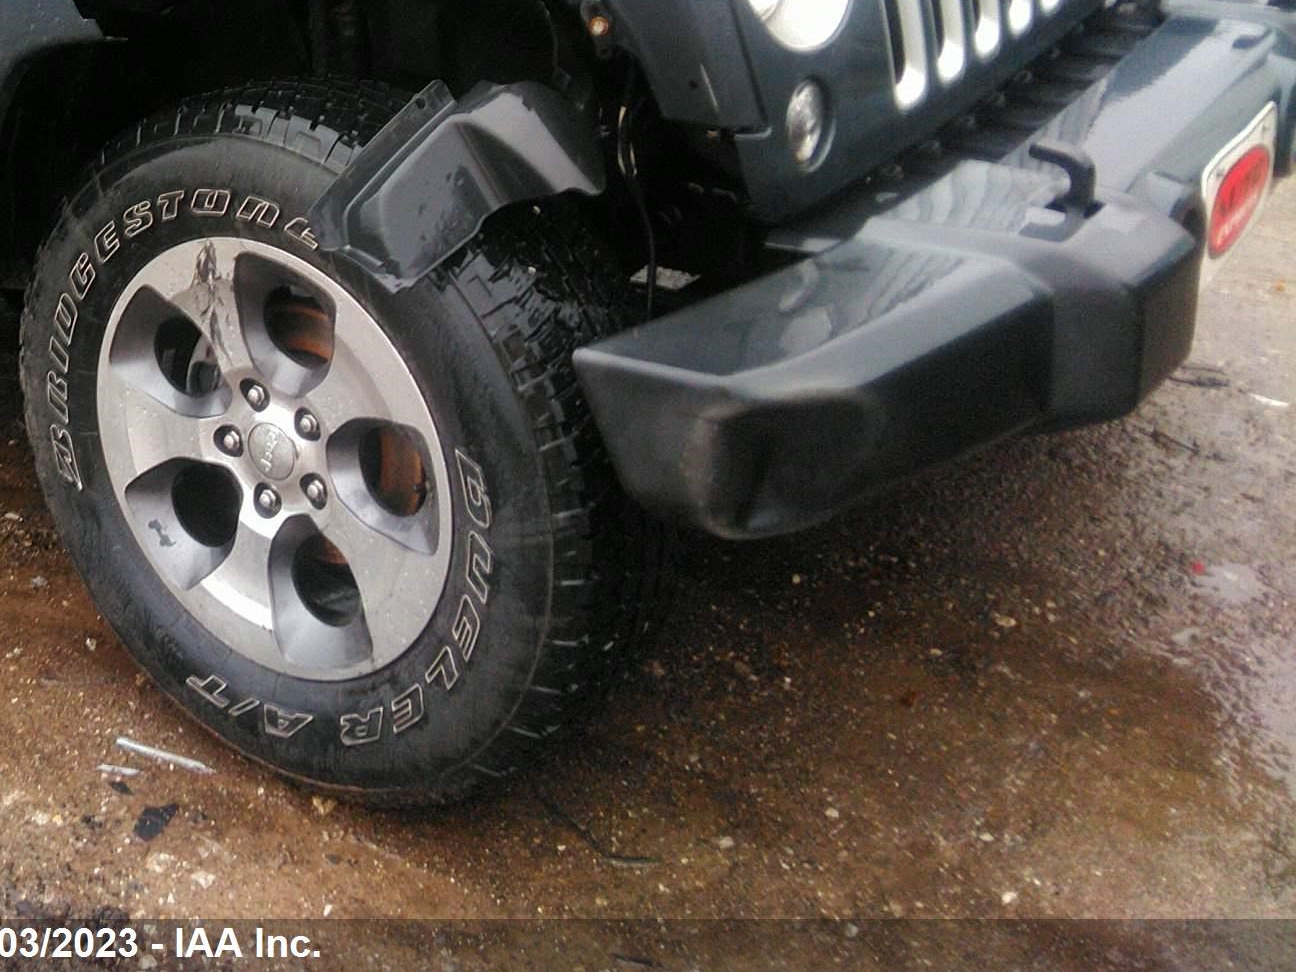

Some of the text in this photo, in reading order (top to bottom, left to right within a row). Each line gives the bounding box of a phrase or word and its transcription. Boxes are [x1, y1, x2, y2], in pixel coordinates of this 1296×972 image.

[46, 187, 320, 493] BRIDGESTONE
[185, 448, 494, 747] DUELER A/T
